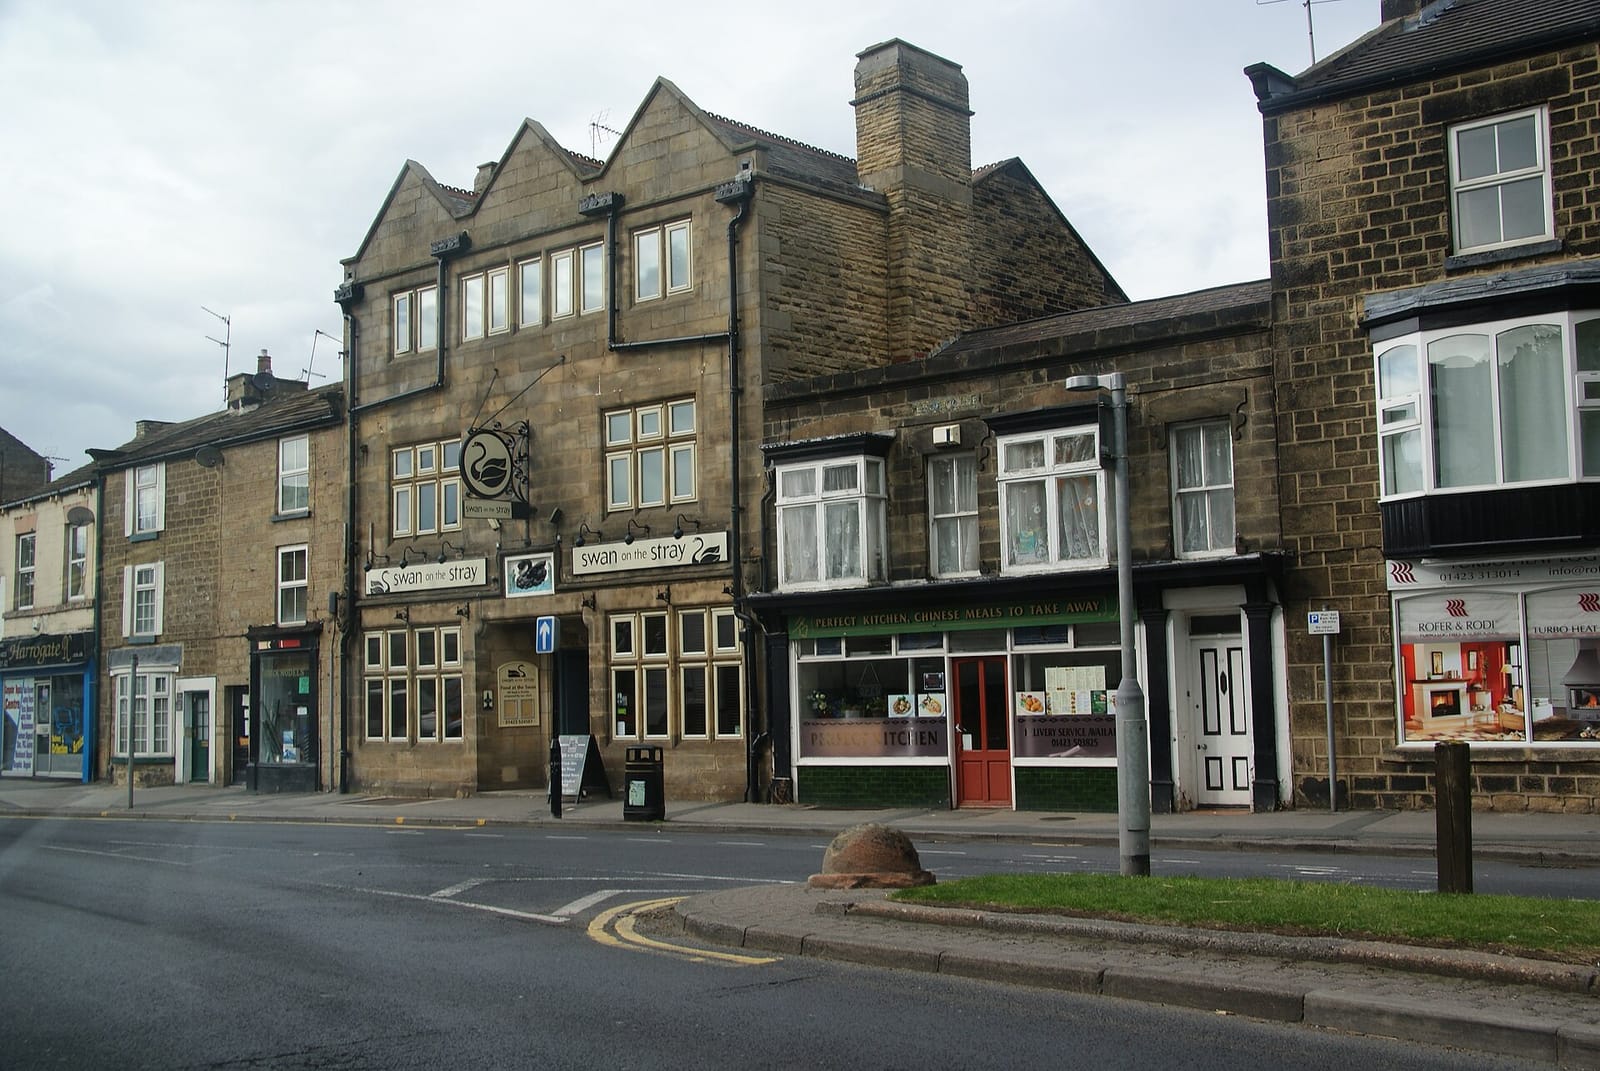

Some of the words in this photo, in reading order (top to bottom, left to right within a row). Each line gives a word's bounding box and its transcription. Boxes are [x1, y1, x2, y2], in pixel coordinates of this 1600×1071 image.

[581, 550, 618, 567] swan
[621, 552, 632, 561] on
[634, 548, 647, 560] the
[650, 543, 686, 562] stray
[393, 571, 423, 586] swan
[425, 573, 434, 581] on
[435, 569, 446, 581] the
[449, 565, 478, 582] stray
[1440, 572, 1474, 582] 01423
[1478, 569, 1521, 579] 313014
[815, 616, 857, 628] PERFECT
[863, 613, 911, 625] KITCHEN,
[914, 609, 960, 622] CHINESE
[965, 608, 1002, 619] MEALS
[1008, 606, 1024, 617] TO
[1030, 603, 1059, 615] TAKE
[1066, 601, 1100, 613] AWAY
[1418, 621, 1453, 632] ROFER
[1455, 621, 1463, 631] &
[1466, 619, 1495, 630] RODI
[1533, 625, 1569, 634] TURBO
[9, 640, 61, 665] Harrogate
[1024, 727, 1057, 737] LIVERY
